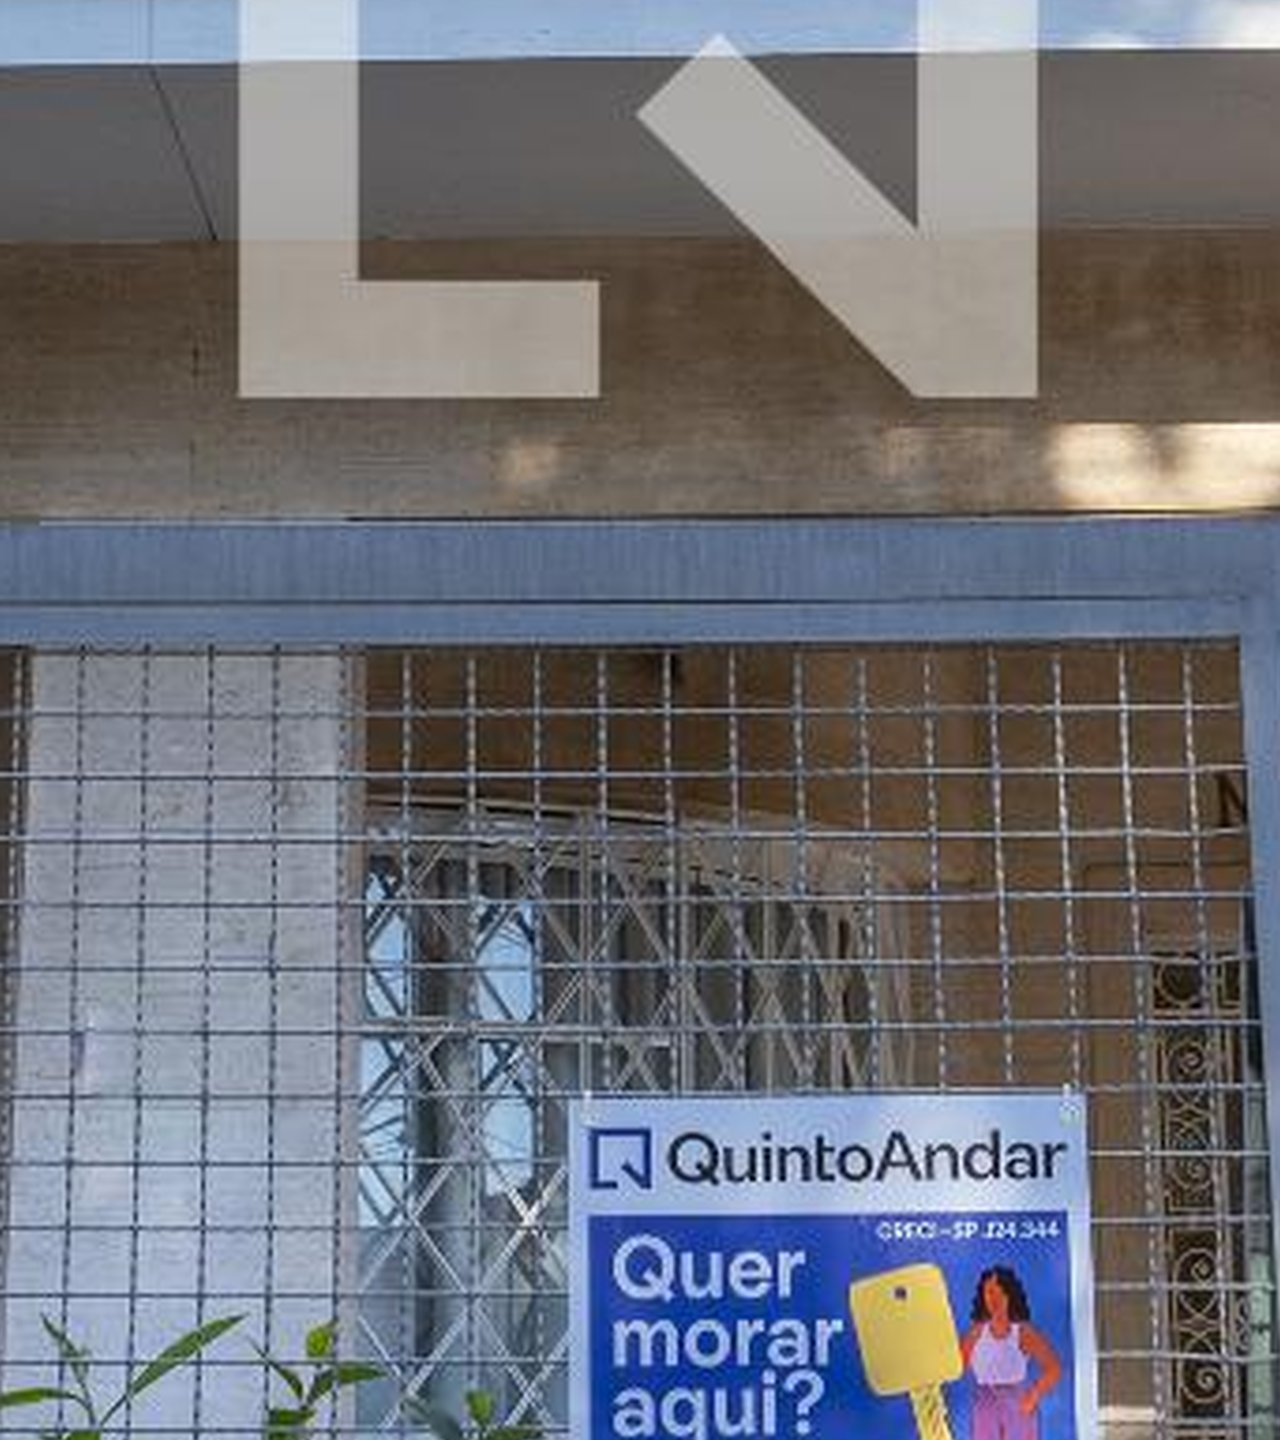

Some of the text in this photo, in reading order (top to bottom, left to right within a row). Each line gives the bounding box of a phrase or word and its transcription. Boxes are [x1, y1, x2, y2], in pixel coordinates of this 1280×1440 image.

[667, 1130, 1068, 1186] QuintoAndar
[612, 1233, 806, 1301] Quer
[612, 1318, 845, 1368] morar
